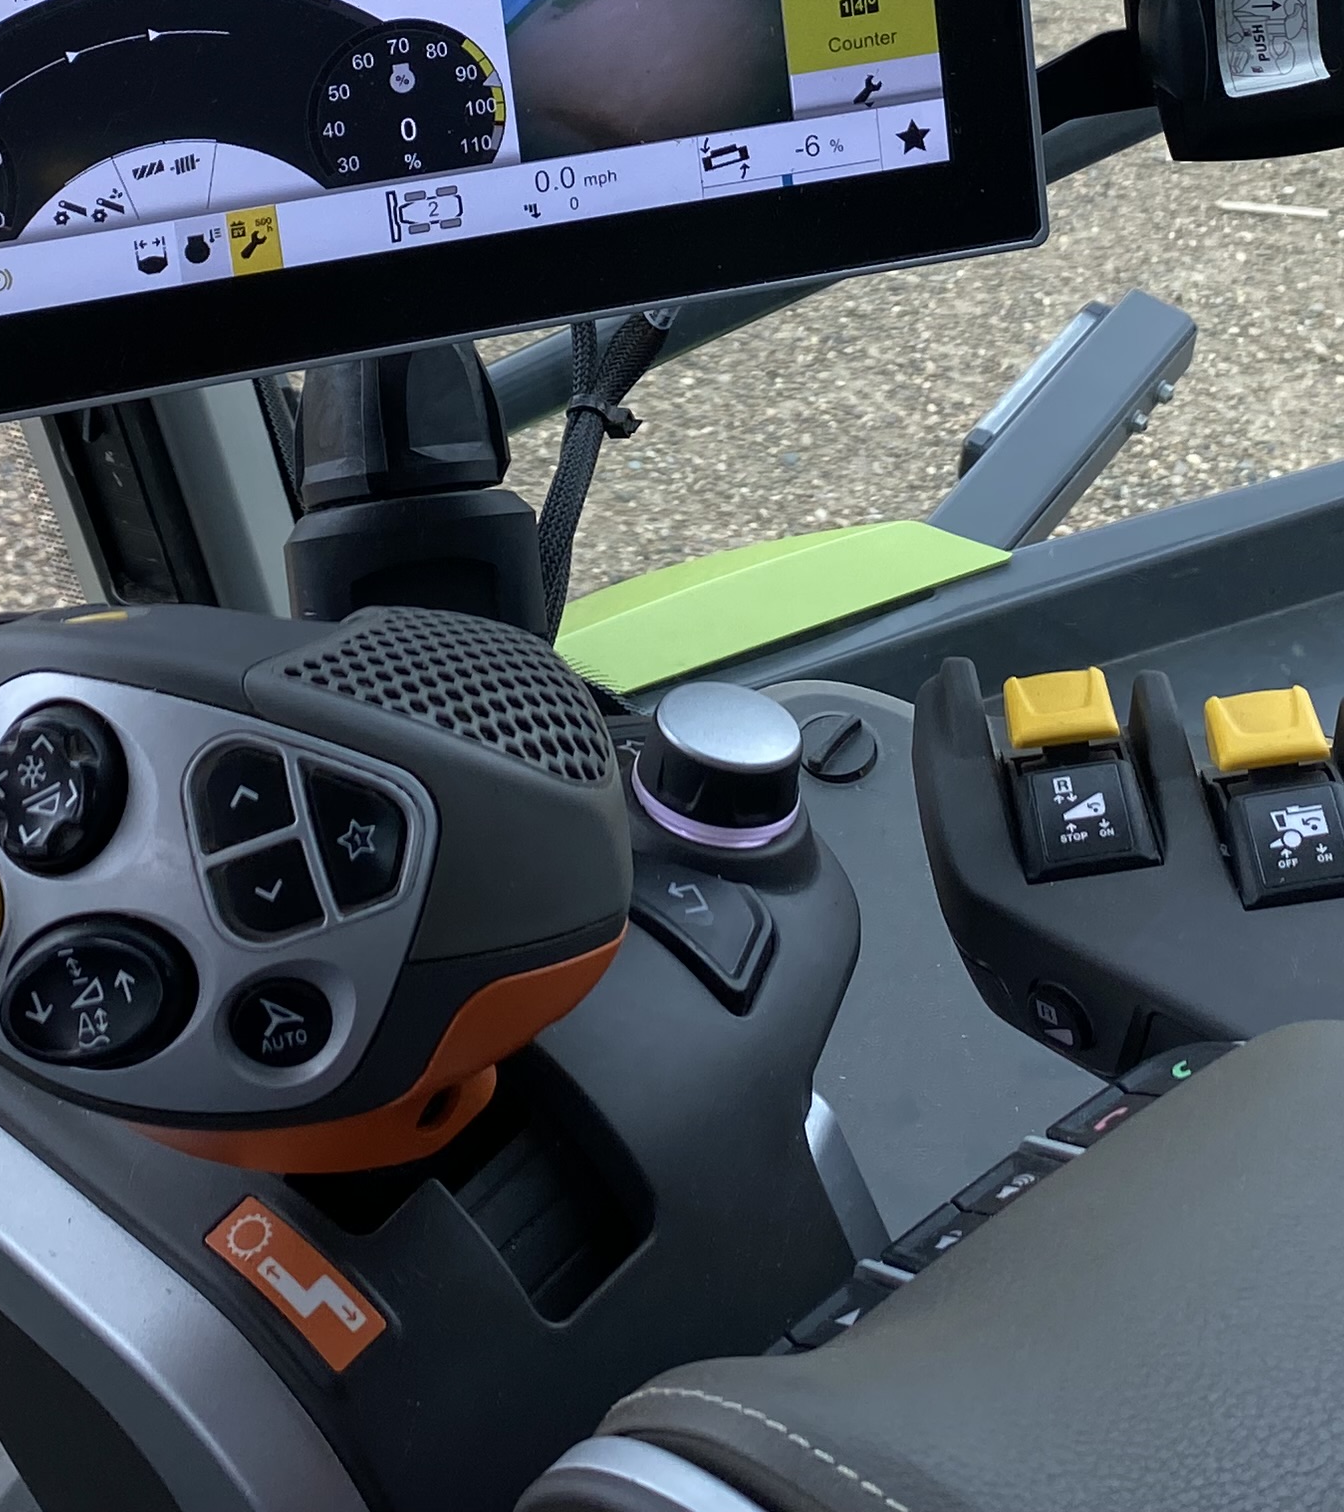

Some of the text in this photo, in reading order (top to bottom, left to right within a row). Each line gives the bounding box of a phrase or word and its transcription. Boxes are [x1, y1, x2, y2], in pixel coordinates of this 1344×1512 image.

[387, 37, 410, 55] 70
[425, 41, 448, 58] 80
[828, 29, 897, 54] Counter
[1251, 24, 1271, 62] PUSH
[352, 52, 375, 70] 60
[455, 64, 478, 82] 90
[328, 84, 350, 101] 50
[465, 97, 496, 116] 100
[323, 121, 345, 138] 40
[401, 118, 417, 141] 0
[460, 135, 492, 154] 110
[795, 135, 844, 159] -6 %
[337, 156, 360, 173] 30
[404, 154, 422, 170] %
[534, 166, 618, 193] 0.0 mph
[429, 200, 439, 218] 2
[569, 197, 579, 210] 0
[1060, 830, 1089, 844] STOP
[1099, 827, 1115, 839] ON
[1278, 857, 1299, 870] OFF
[1317, 852, 1333, 864] ON
[261, 1028, 307, 1055] AUTO
